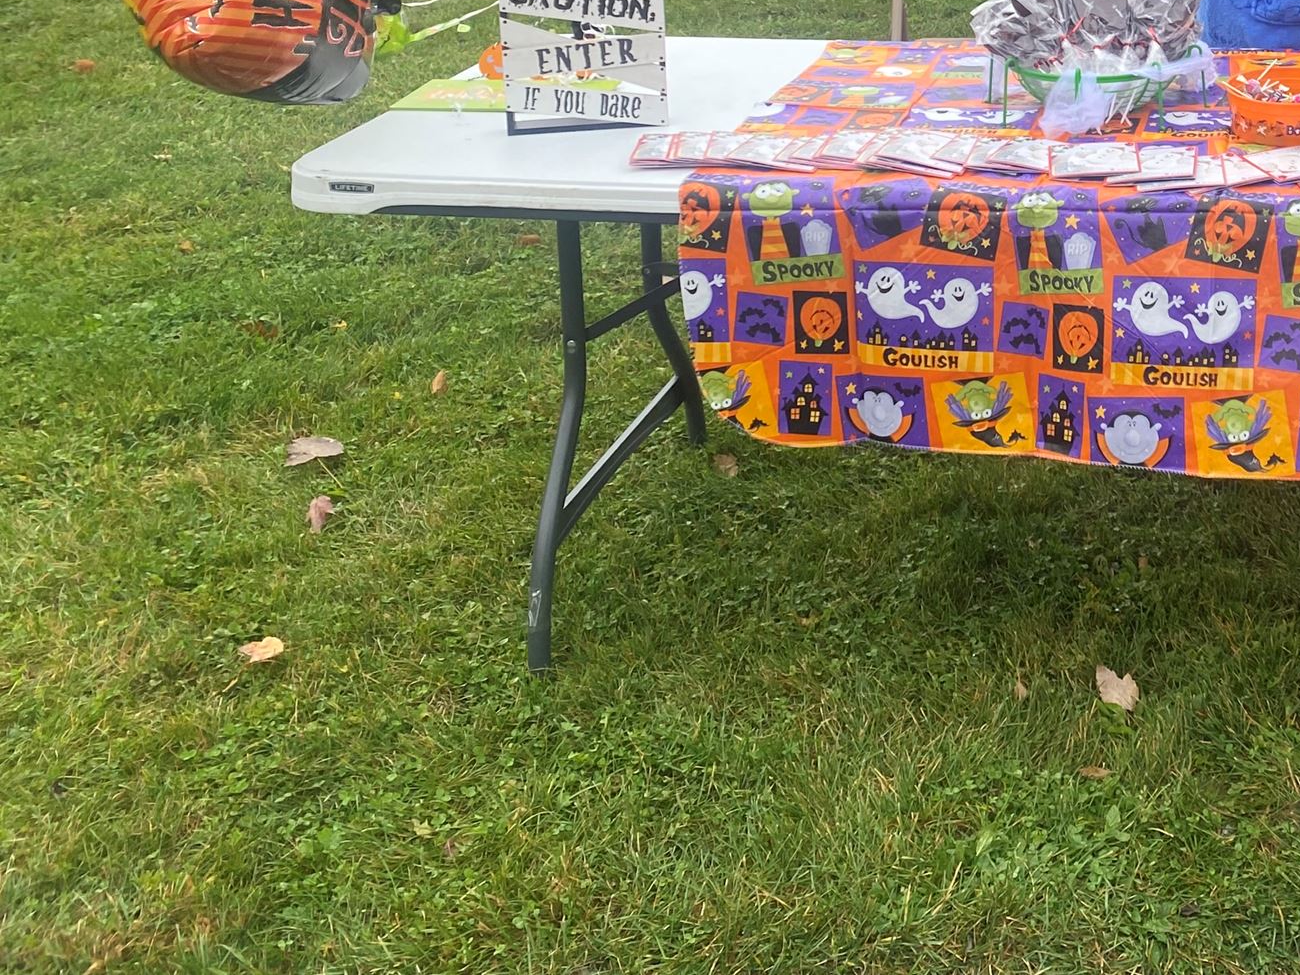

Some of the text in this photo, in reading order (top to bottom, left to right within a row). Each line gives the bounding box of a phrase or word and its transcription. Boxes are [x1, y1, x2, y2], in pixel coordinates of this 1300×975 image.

[536, 38, 637, 74] ENTER
[524, 87, 540, 110] IF
[554, 89, 586, 114] YOU
[1068, 242, 1087, 254] RIP
[762, 259, 835, 282] SPOOKY
[1029, 272, 1095, 293] SPOOKY
[882, 347, 958, 369] GOULISH
[1143, 366, 1218, 387] GOULISH
